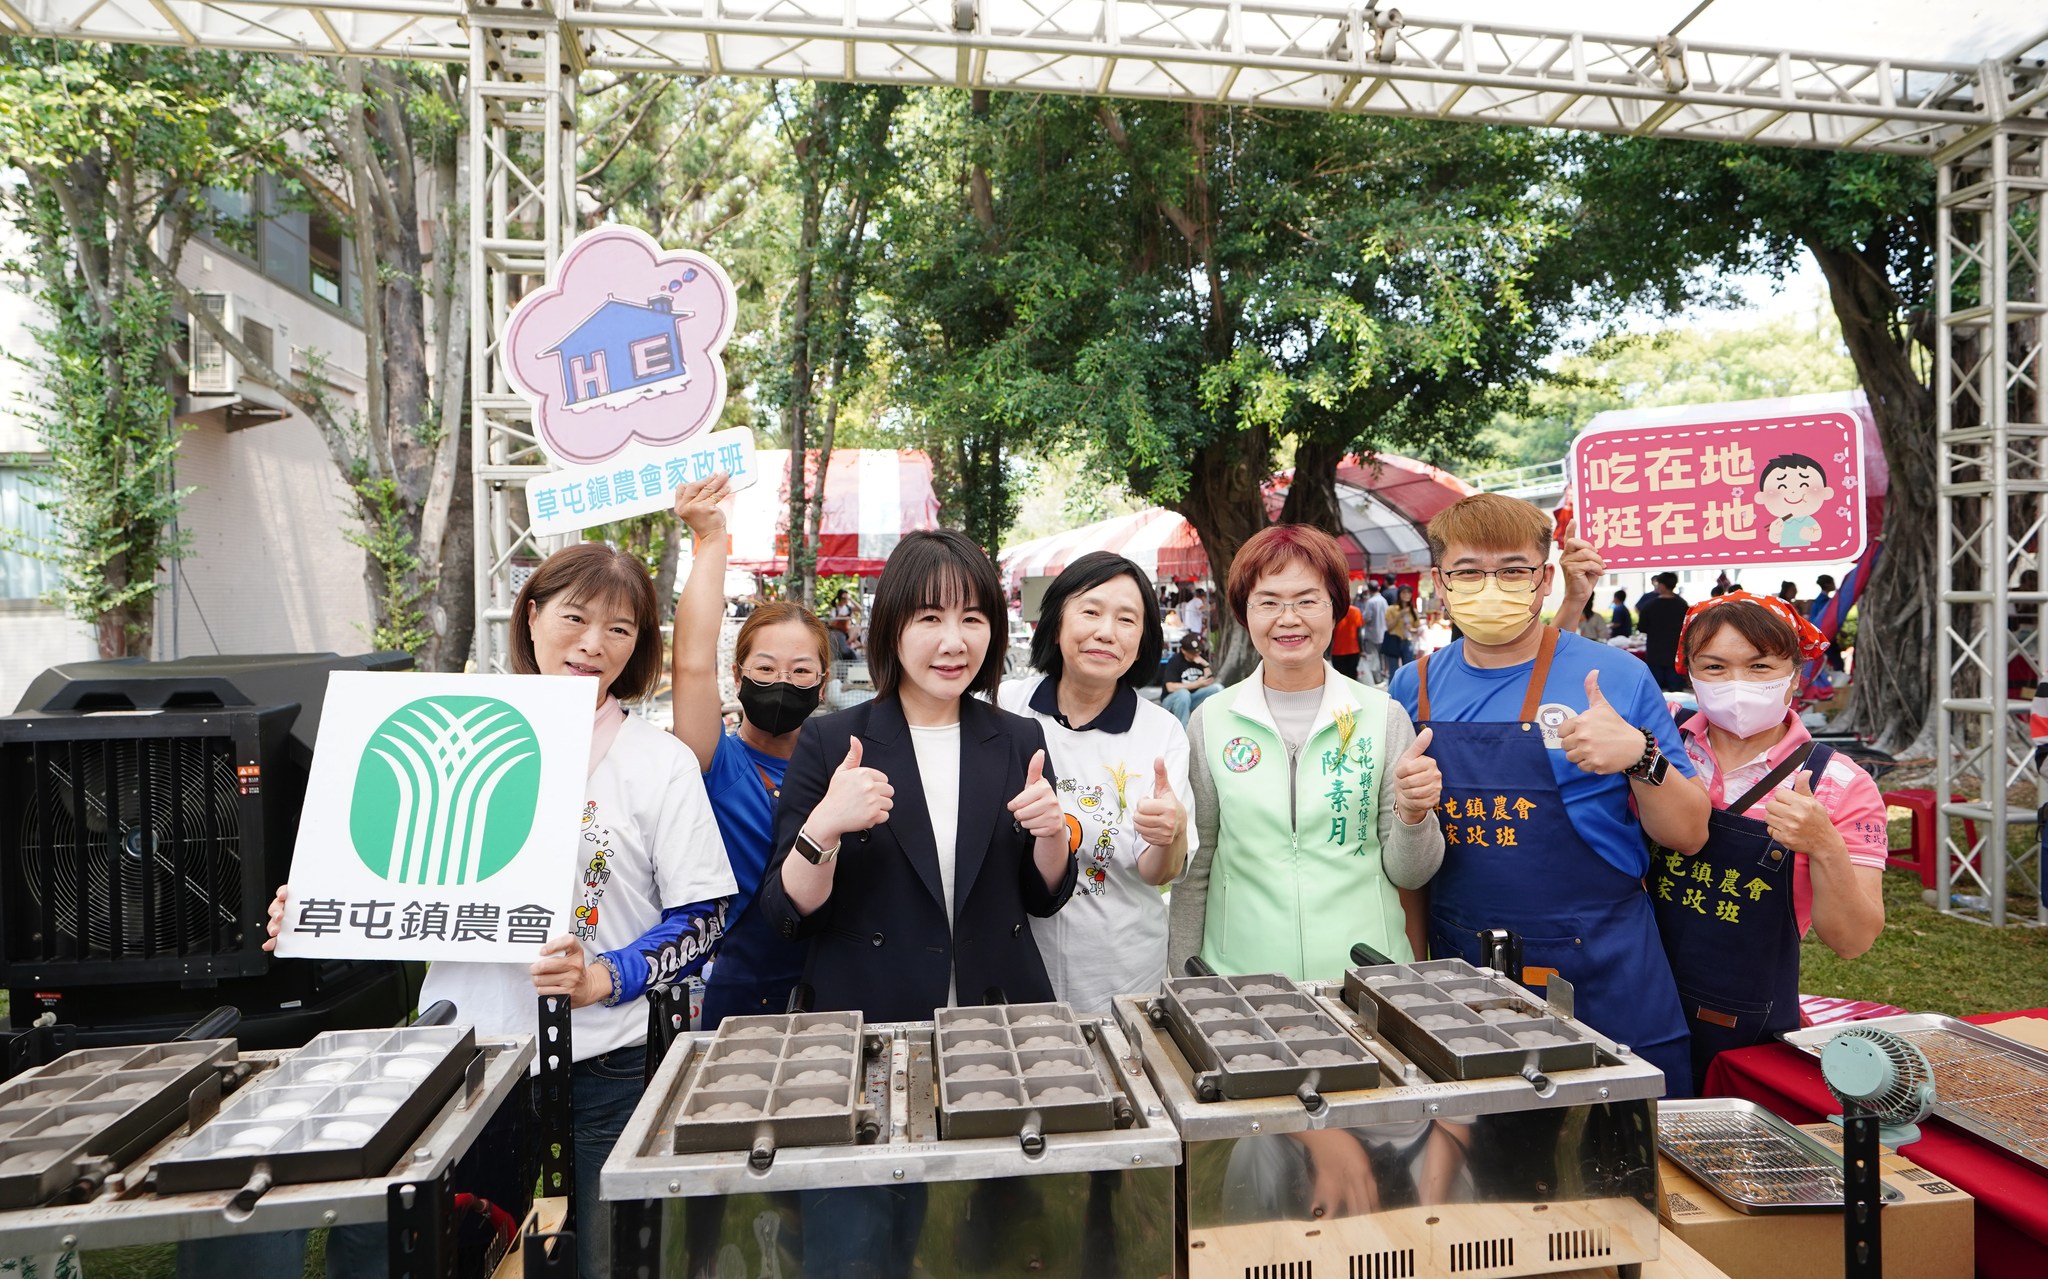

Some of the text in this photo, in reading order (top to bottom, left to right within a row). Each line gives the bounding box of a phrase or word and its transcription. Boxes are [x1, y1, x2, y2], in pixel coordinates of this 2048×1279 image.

[534, 442, 747, 522] 草屯鎮農會家政班
[1589, 441, 1755, 494] 吃在地
[1591, 497, 1757, 549] 挺在地
[1321, 747, 1354, 847] 陳素月
[1353, 736, 1375, 857] 彰化縣長候選人
[1433, 795, 1537, 821] 屯鎮農會
[1445, 823, 1518, 847] 家政班
[293, 897, 556, 944] 草屯鎮農會
[1657, 875, 1741, 924] 家政班
